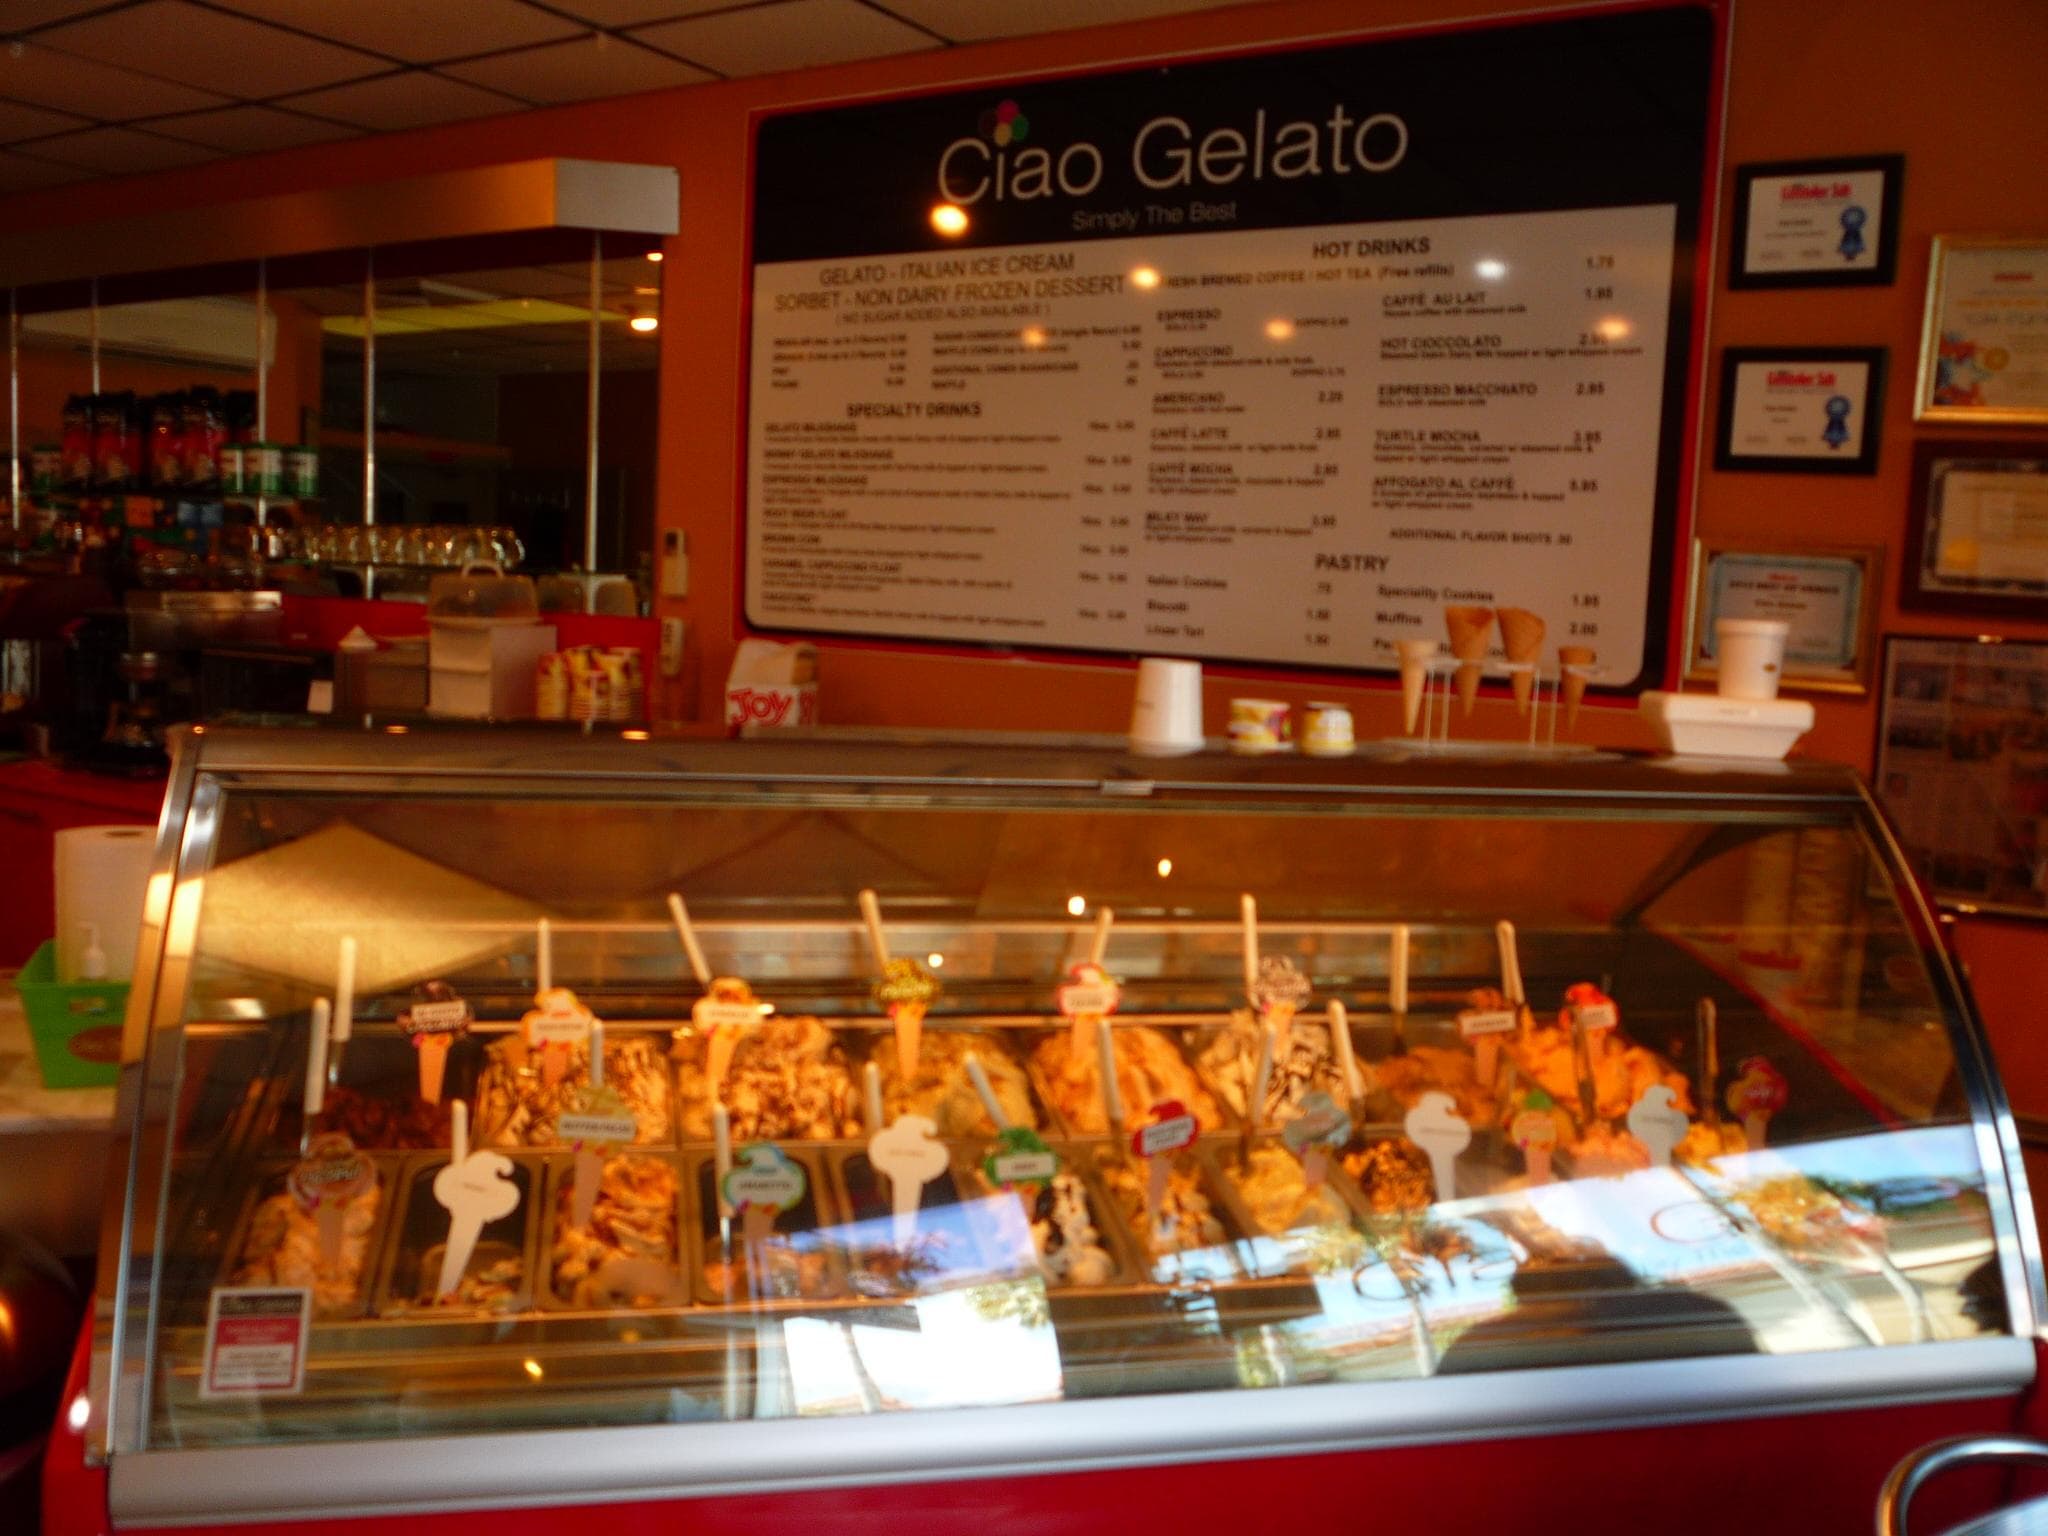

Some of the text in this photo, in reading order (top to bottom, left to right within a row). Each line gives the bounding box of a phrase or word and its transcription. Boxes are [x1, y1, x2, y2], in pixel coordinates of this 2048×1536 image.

[937, 104, 1409, 207] Ciao Gelato
[1072, 200, 1237, 233] Simply The Best
[1312, 237, 1431, 259] HOT DRINKS
[819, 253, 1075, 286] GELATO ITALIAN ICE CREAM
[1201, 273, 1253, 287] BREWED
[1256, 271, 1304, 284] COFFEE
[1316, 268, 1343, 281] HOT
[1347, 266, 1371, 279] TEA
[774, 274, 1125, 312] SORBET NON DAIRY FROZEN DESSERT
[1380, 336, 1408, 349] HOT
[1378, 382, 1538, 398] ESPRESSO MACCHIATO
[847, 401, 982, 418] SPECIALTY DRINKS
[1315, 554, 1389, 572] PASTRY
[1442, 587, 1494, 602] Cookies
[1375, 611, 1423, 626] Muffins
